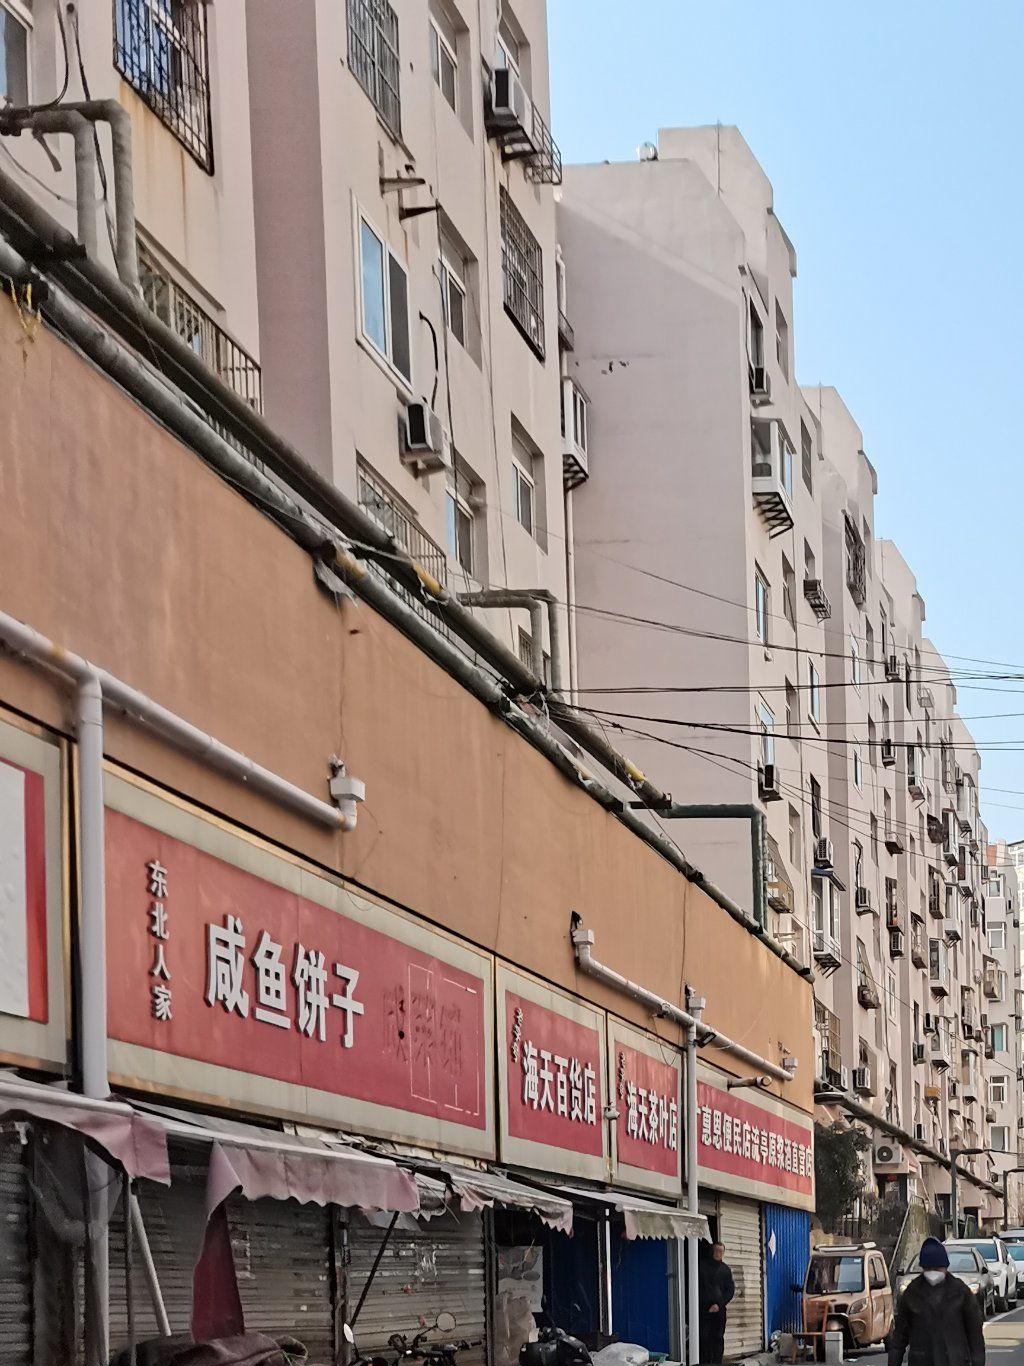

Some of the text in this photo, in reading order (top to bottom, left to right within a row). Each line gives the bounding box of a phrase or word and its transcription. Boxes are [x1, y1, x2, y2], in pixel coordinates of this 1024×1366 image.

[146, 860, 173, 1022] 东北人家
[205, 914, 365, 1049] 咸鱼饼子
[523, 1040, 596, 1126] 海天百货店
[626, 1080, 678, 1152] 海天茶叶店
